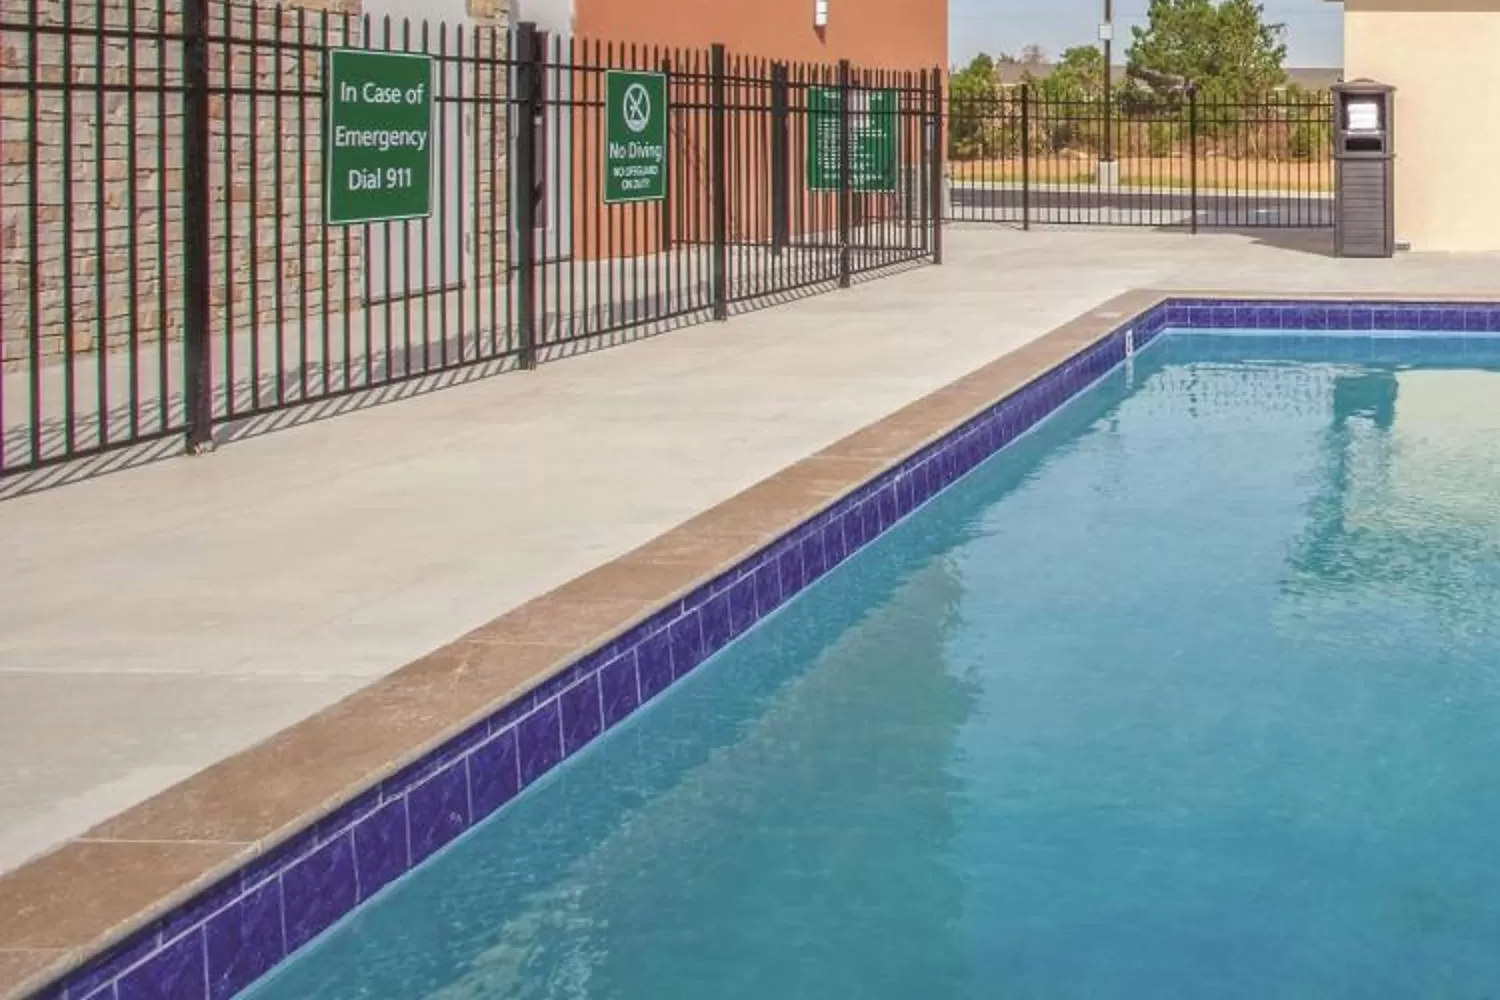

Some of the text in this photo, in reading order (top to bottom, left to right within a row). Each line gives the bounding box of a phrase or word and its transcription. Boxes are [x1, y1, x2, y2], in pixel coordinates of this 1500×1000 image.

[341, 81, 424, 104] In Case of
[335, 125, 427, 151] Emergency
[609, 141, 663, 163] No Diving
[348, 168, 412, 190] Dial 911
